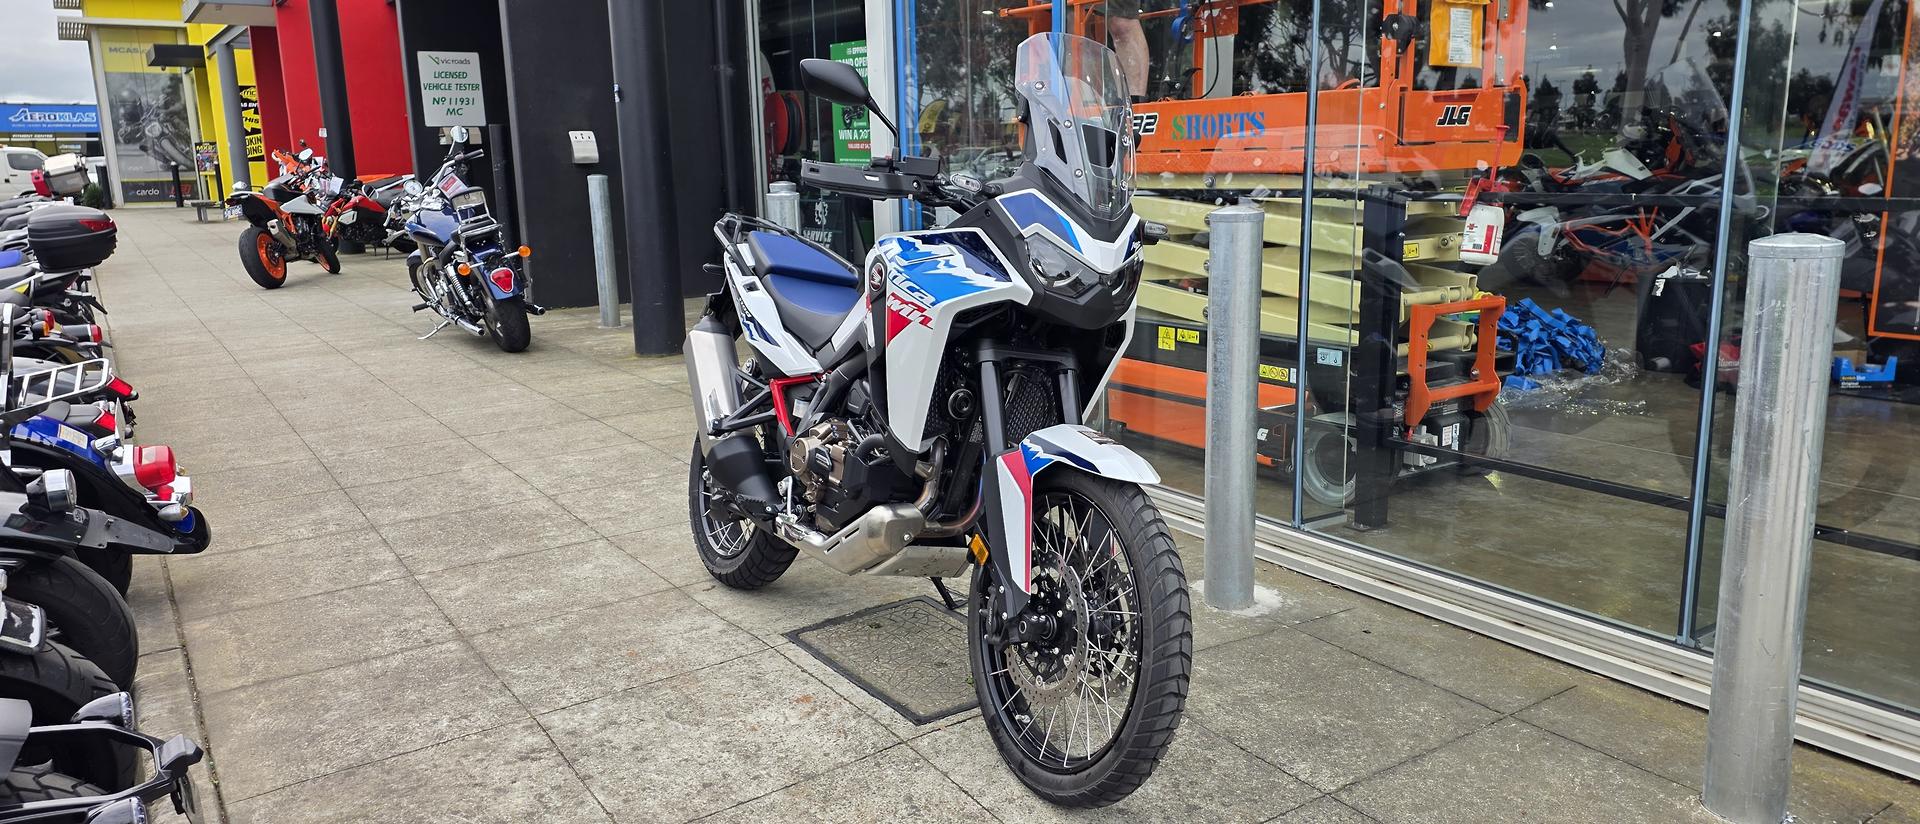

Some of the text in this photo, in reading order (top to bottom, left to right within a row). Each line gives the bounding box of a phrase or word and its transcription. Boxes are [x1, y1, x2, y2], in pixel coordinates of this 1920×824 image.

[433, 71, 468, 79] LICENSED
[423, 83, 480, 91] VEHICLE TESTER
[449, 97, 475, 105] 11931
[8, 108, 97, 122] AEROKLAS
[446, 108, 464, 116] MC
[1436, 105, 1472, 127] JLG
[1172, 111, 1265, 140] SHORTS
[839, 130, 852, 140] WIN
[853, 130, 859, 140] A
[136, 188, 160, 196] cardo
[803, 230, 833, 243] SERVICE
